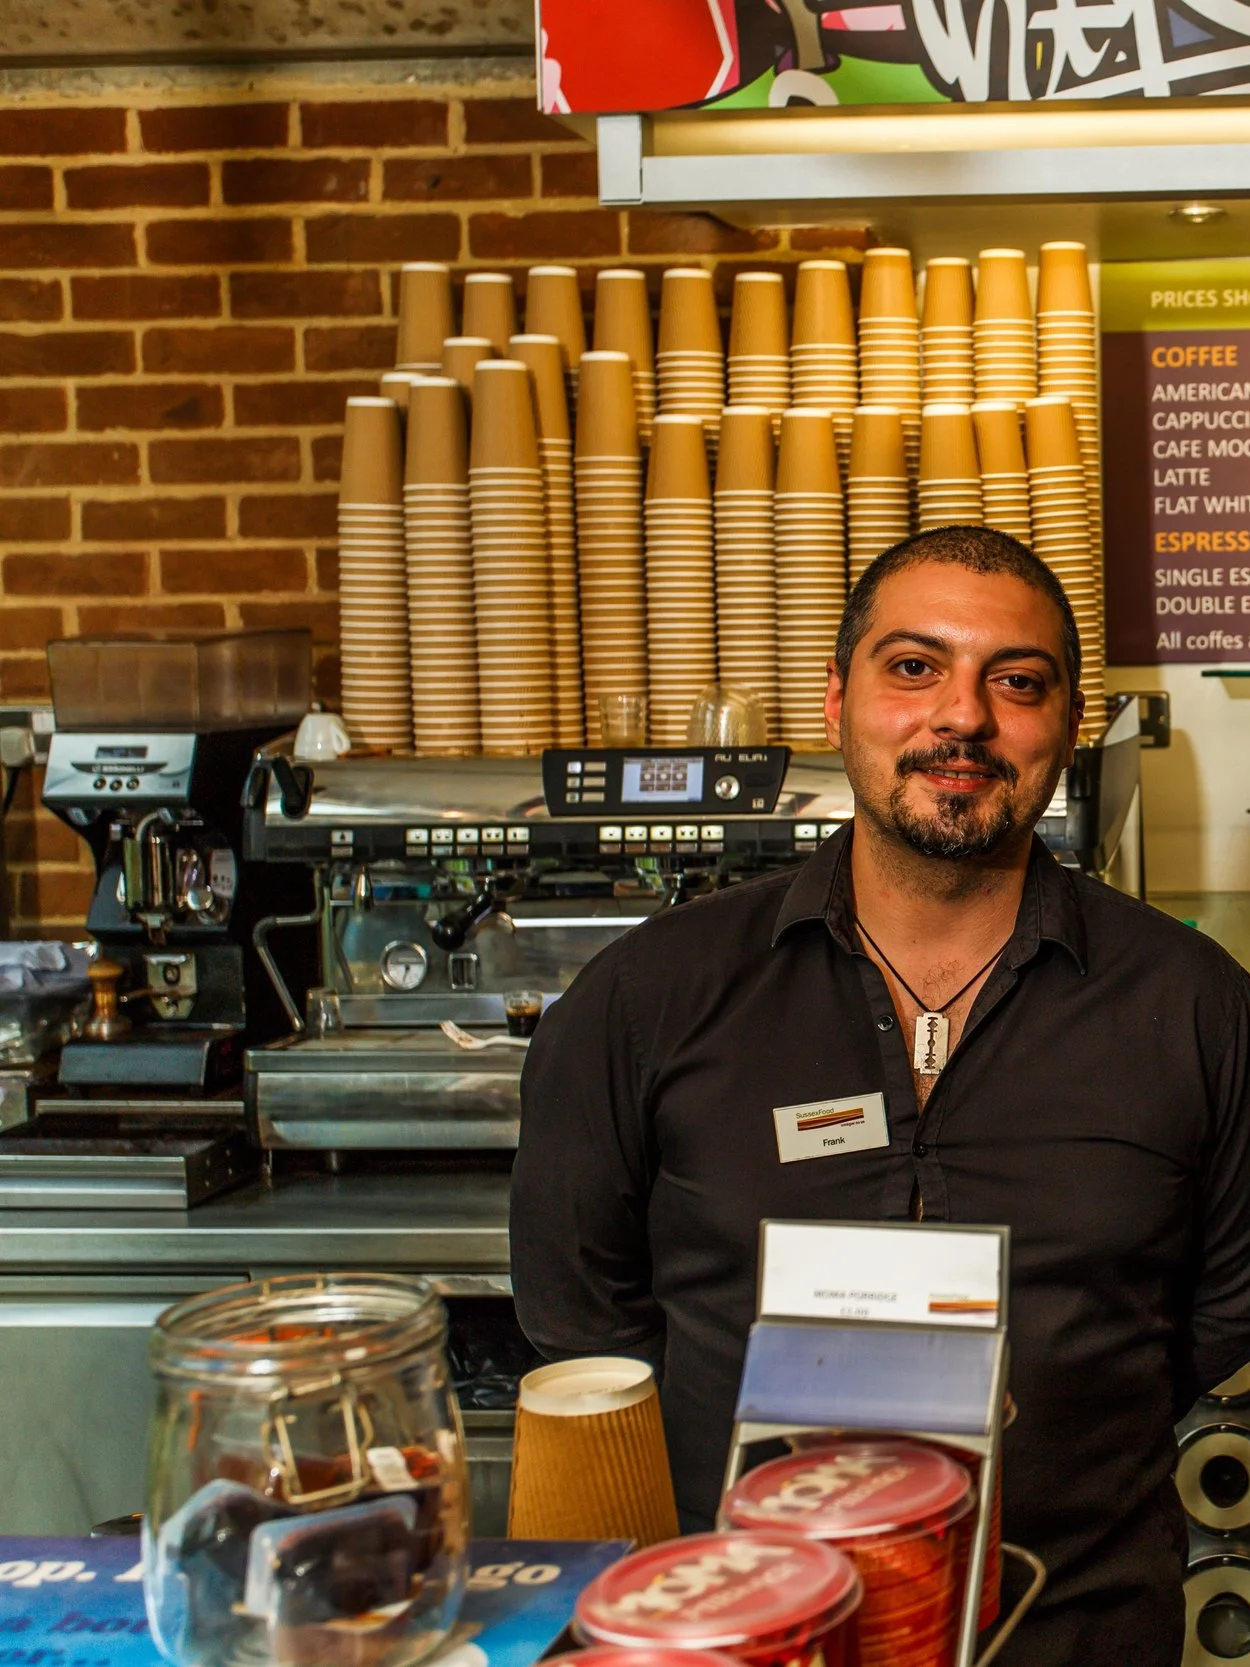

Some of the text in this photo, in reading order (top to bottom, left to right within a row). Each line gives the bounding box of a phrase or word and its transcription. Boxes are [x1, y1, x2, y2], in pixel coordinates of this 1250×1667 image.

[1151, 289, 1218, 308] PRICES
[1151, 345, 1238, 368] COFFEE
[1153, 439, 1202, 458] CAFE
[1154, 468, 1211, 487] LATTE
[1154, 496, 1199, 515] FLAT
[1154, 568, 1224, 587] SINGLE
[1155, 596, 1236, 615] DOUBLE
[1156, 631, 1182, 650] All
[1186, 630, 1244, 650] coffes
[796, 1107, 835, 1120] SussexFood
[822, 1136, 846, 1147] Frank
